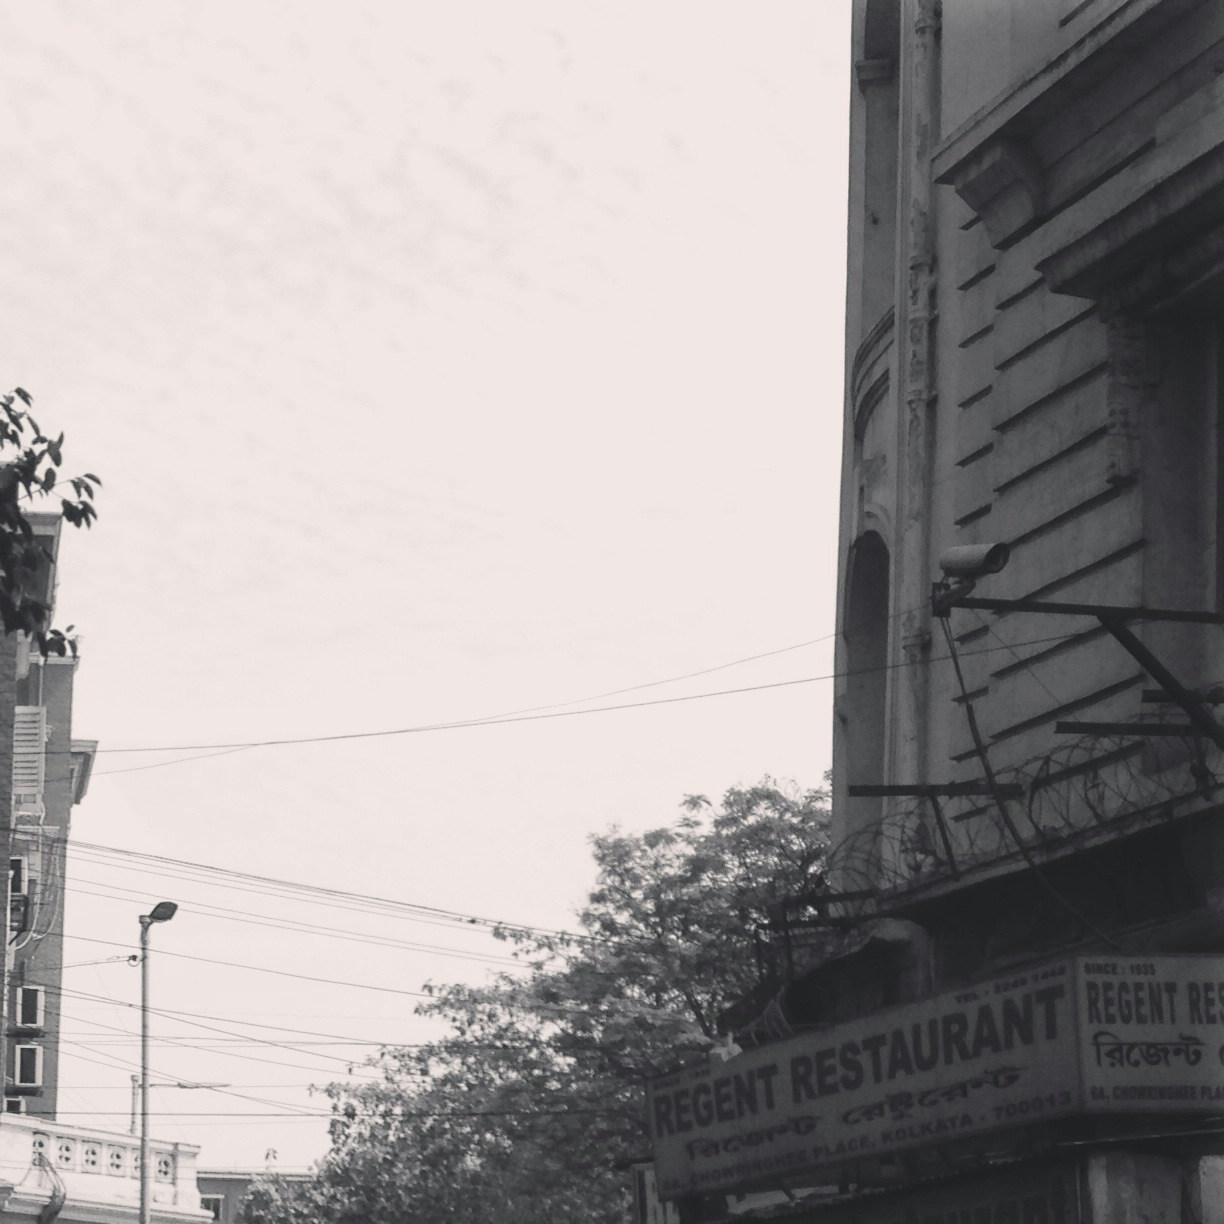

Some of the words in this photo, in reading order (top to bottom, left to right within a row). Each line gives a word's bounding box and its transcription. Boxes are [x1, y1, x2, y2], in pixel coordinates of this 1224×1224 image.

[1086, 981, 1177, 1024] REGENT
[654, 1063, 779, 1138] REGENT
[790, 984, 1064, 1103] RESTAURANT
[1092, 1031, 1205, 1067] রিজেন্ট
[685, 1116, 819, 1160] রিজেন্ট
[881, 1113, 974, 1144] KOLKATA
[992, 1091, 1071, 1119] 700013
